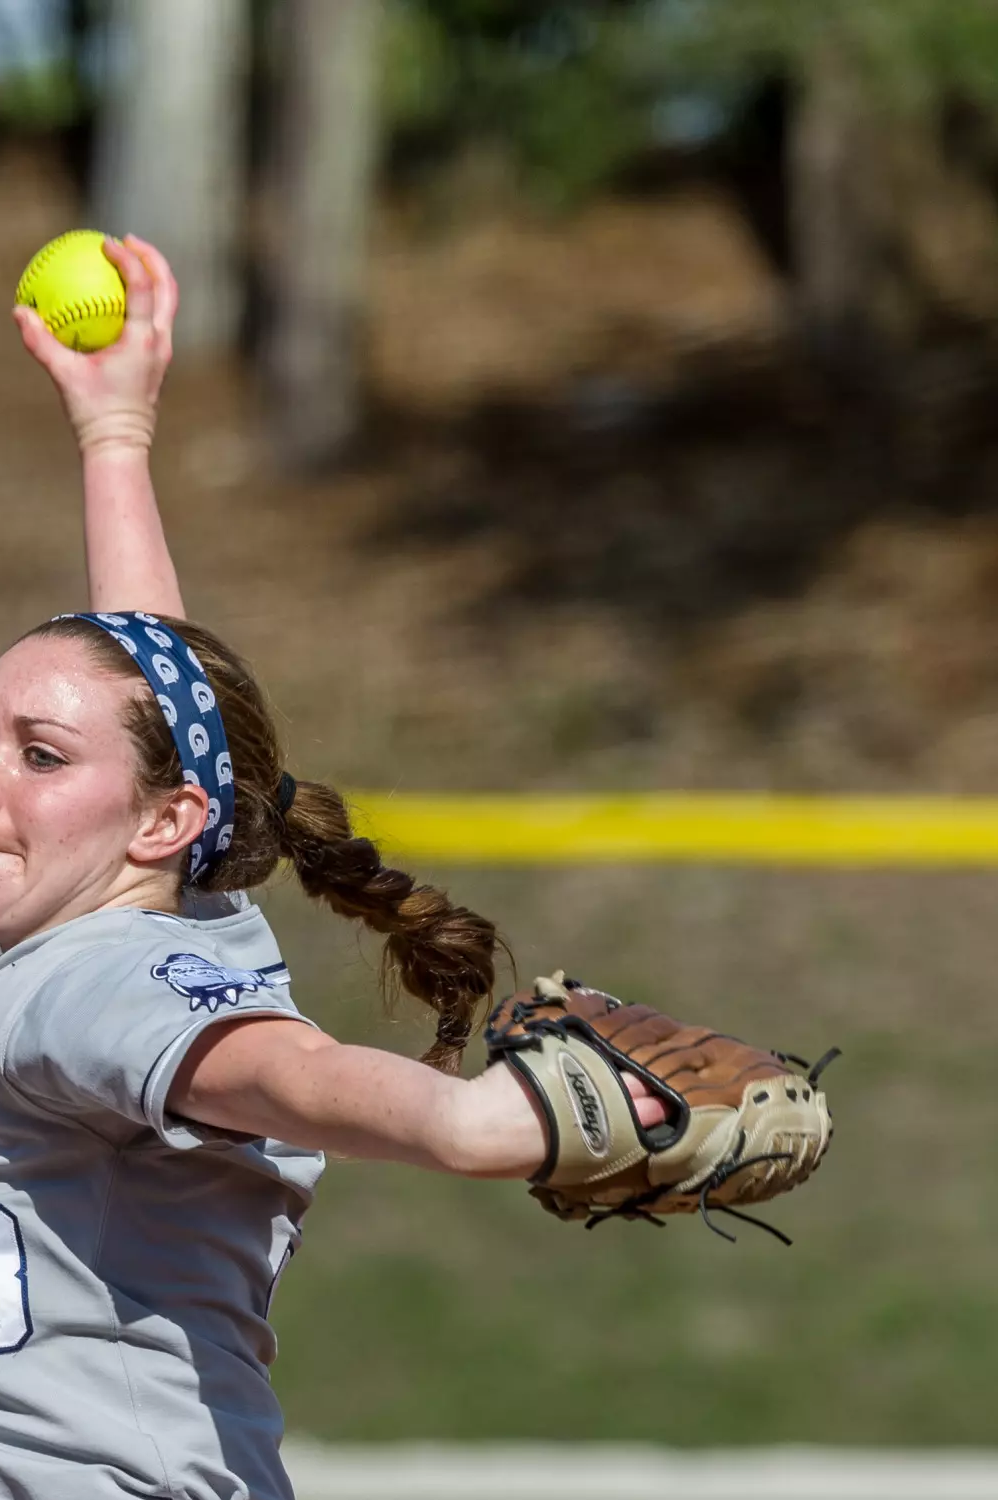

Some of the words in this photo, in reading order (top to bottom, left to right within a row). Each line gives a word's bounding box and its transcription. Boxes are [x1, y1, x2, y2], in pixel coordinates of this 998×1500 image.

[145, 626, 172, 648] G
[152, 654, 179, 685] G
[191, 681, 215, 713] G
[188, 723, 210, 758] G
[215, 752, 233, 787] G
